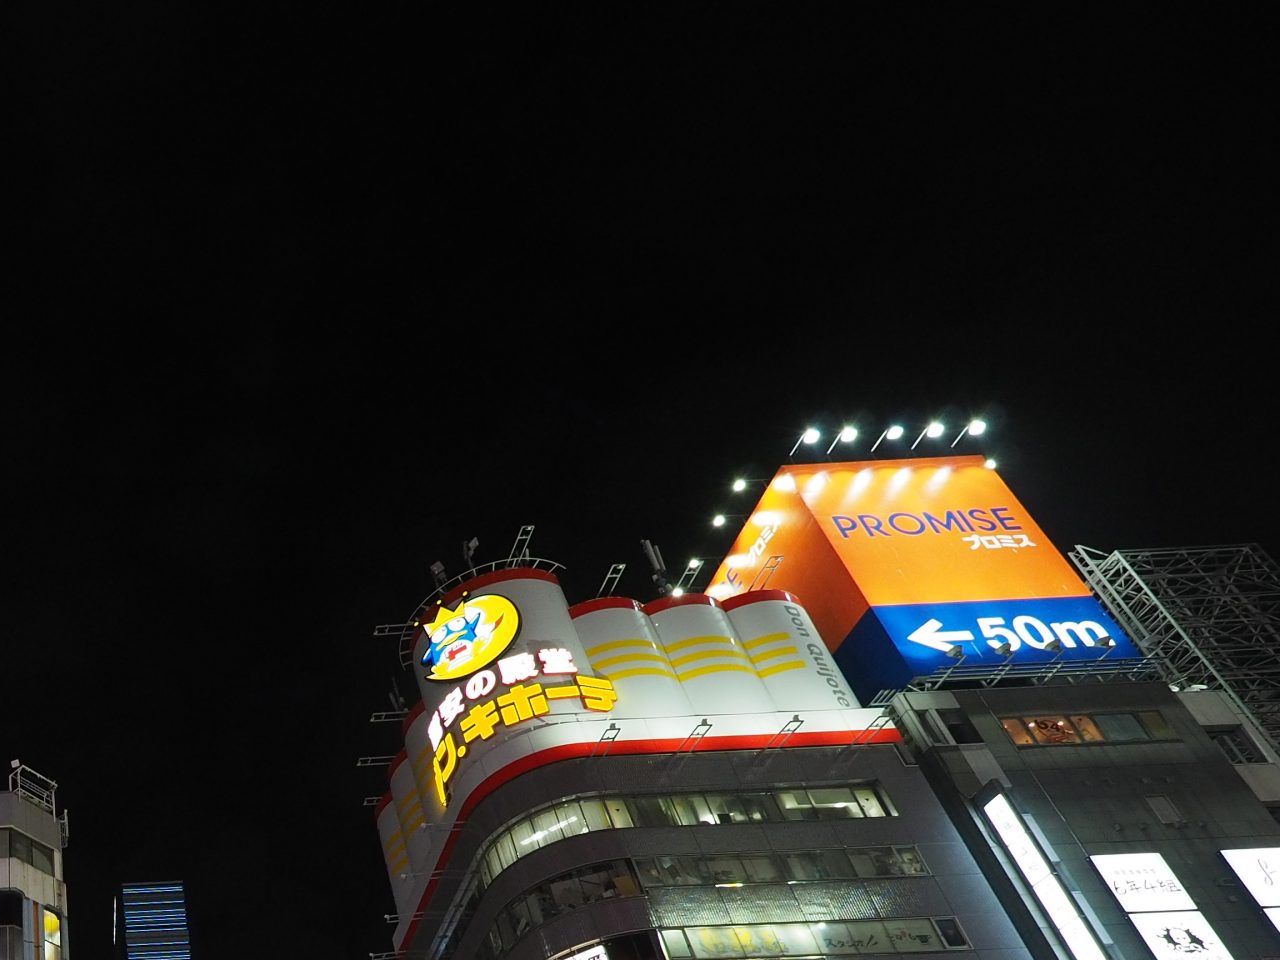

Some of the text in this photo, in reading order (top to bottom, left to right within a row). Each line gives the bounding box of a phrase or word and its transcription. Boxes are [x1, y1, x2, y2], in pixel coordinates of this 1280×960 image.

[831, 507, 1023, 540] PROMISE
[962, 534, 1037, 550] プロミス
[977, 615, 1116, 652] 50m
[784, 605, 850, 708] Don Quijote
